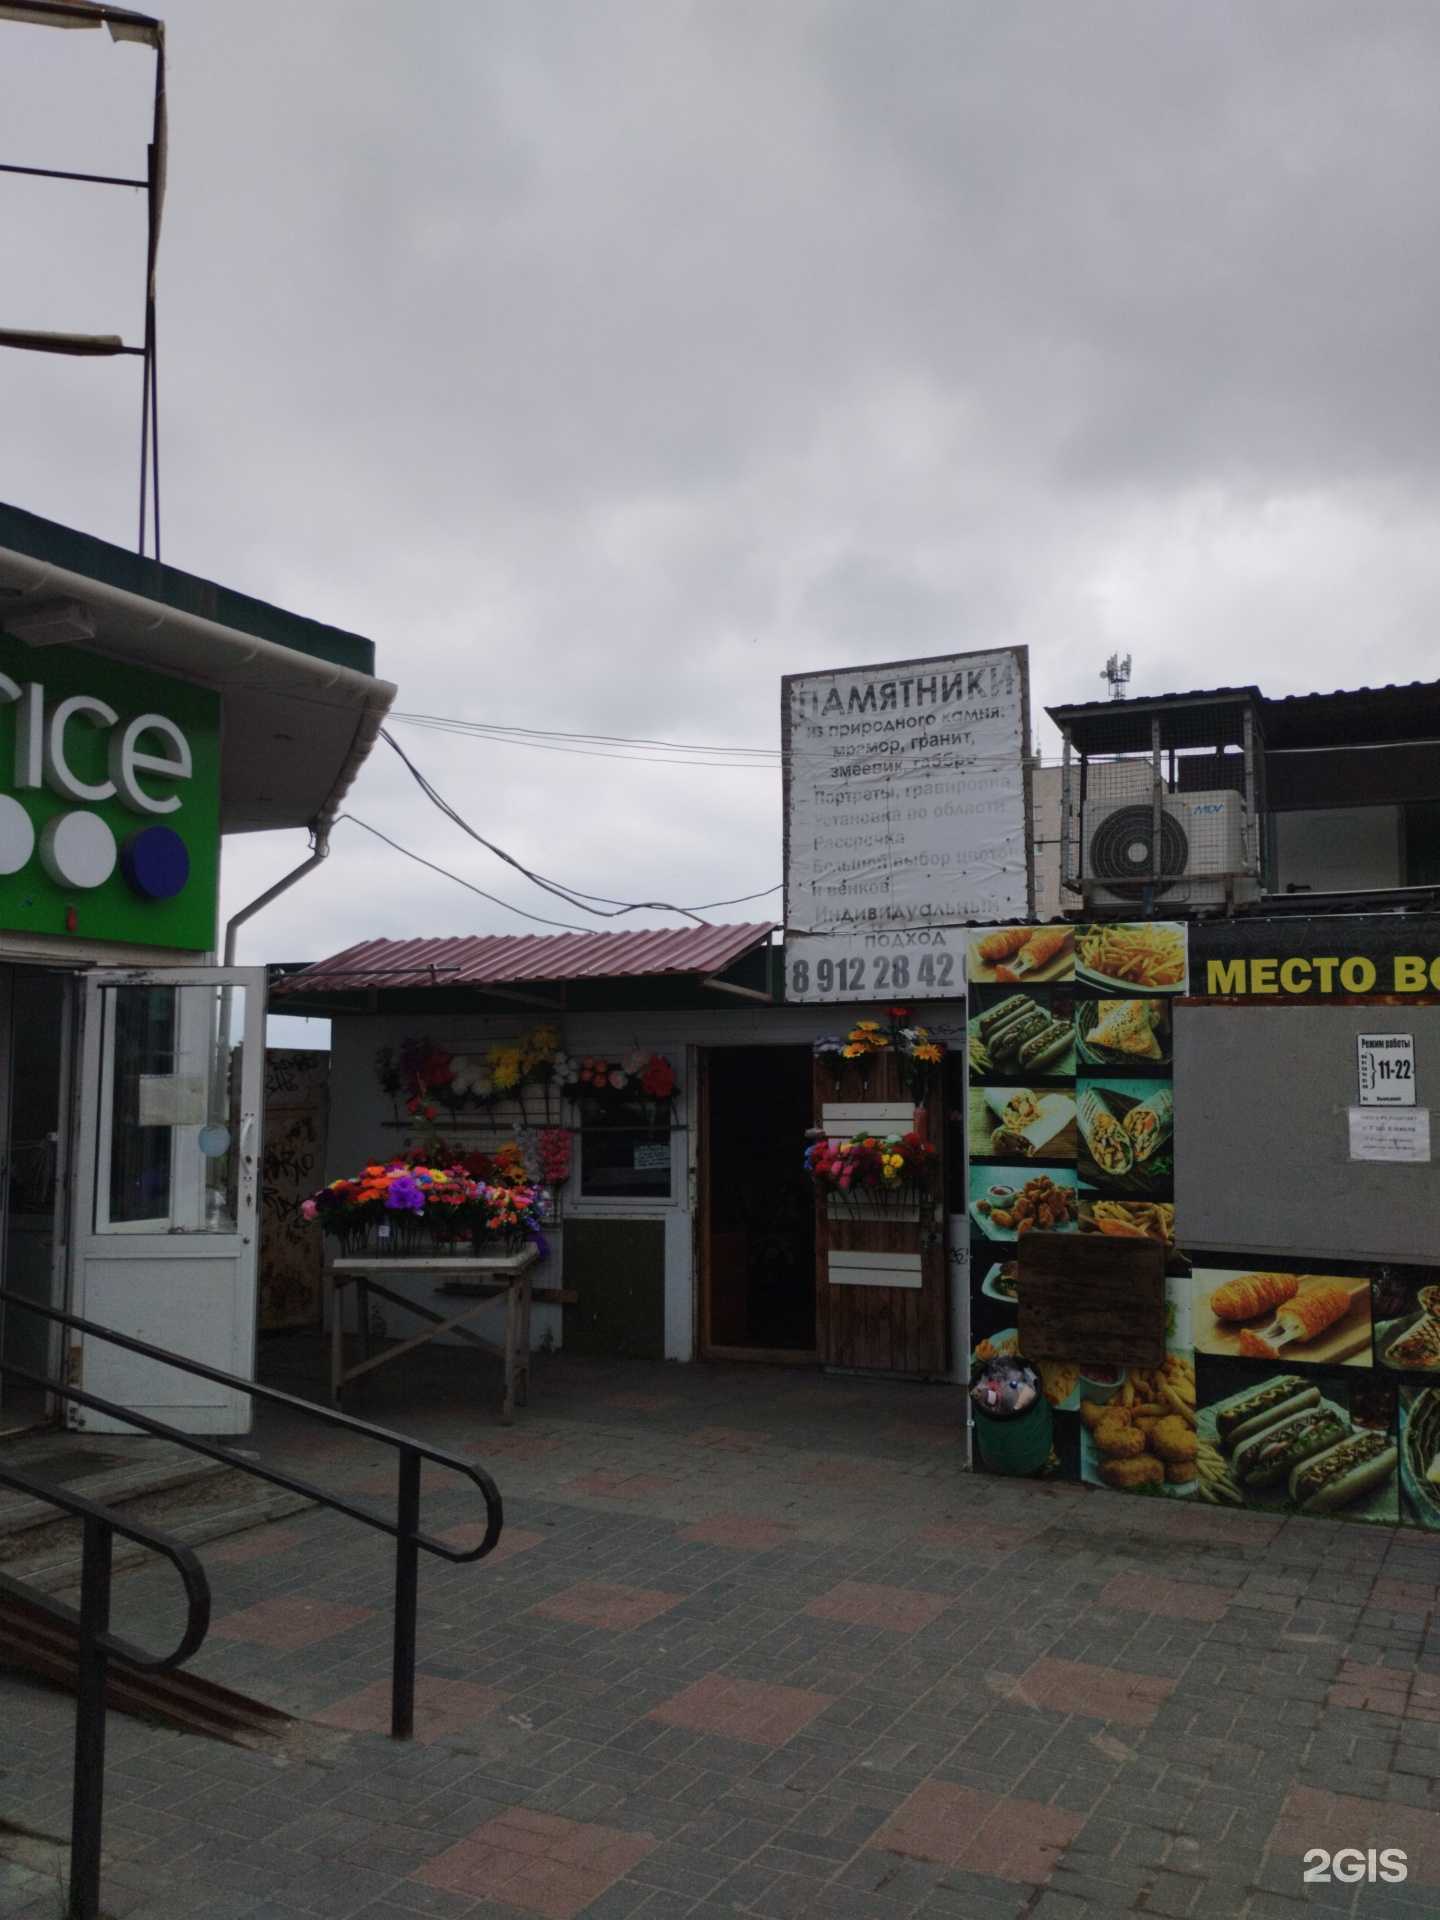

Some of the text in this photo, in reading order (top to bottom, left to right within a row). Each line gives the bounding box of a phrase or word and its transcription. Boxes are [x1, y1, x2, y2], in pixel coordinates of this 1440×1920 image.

[829, 713, 936, 739] природного
[865, 928, 947, 950] подход
[792, 958, 810, 993] 8
[817, 955, 866, 993] 912
[873, 954, 911, 989] 28
[917, 952, 954, 988] 42
[1207, 955, 1440, 994] МЕСТО В
[1378, 1059, 1411, 1079] 11-22
